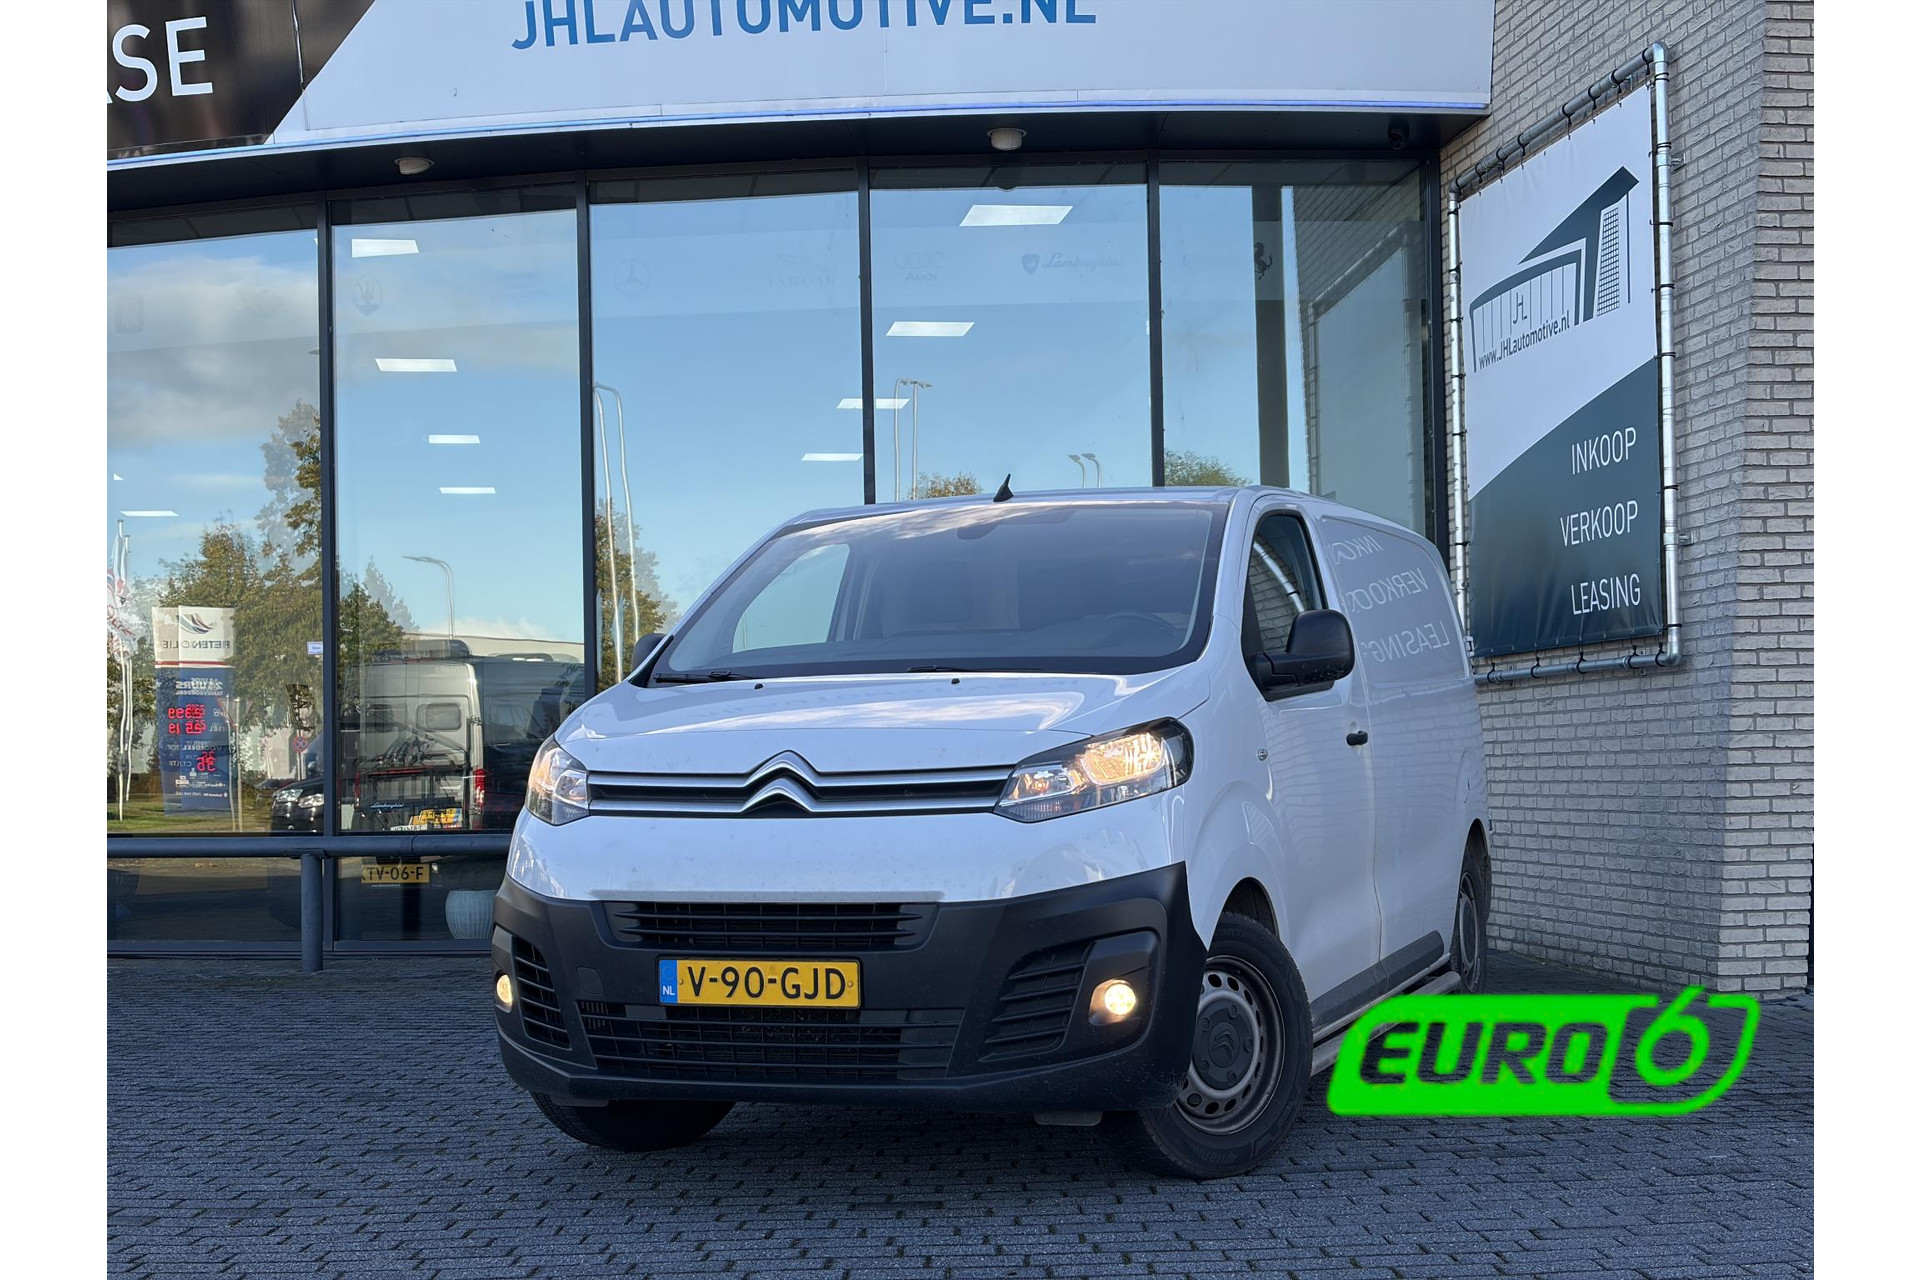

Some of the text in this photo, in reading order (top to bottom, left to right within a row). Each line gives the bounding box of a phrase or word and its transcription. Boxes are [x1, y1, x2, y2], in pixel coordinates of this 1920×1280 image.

[107, 16, 213, 104] SE
[1479, 310, 1570, 370] www.JHLautomotive.nl
[1571, 427, 1636, 475] INKOOP
[1560, 500, 1638, 547] VERKOOP
[1571, 573, 1641, 615] LEASING
[663, 985, 676, 996] NL
[688, 966, 846, 1000] V-90-GJD
